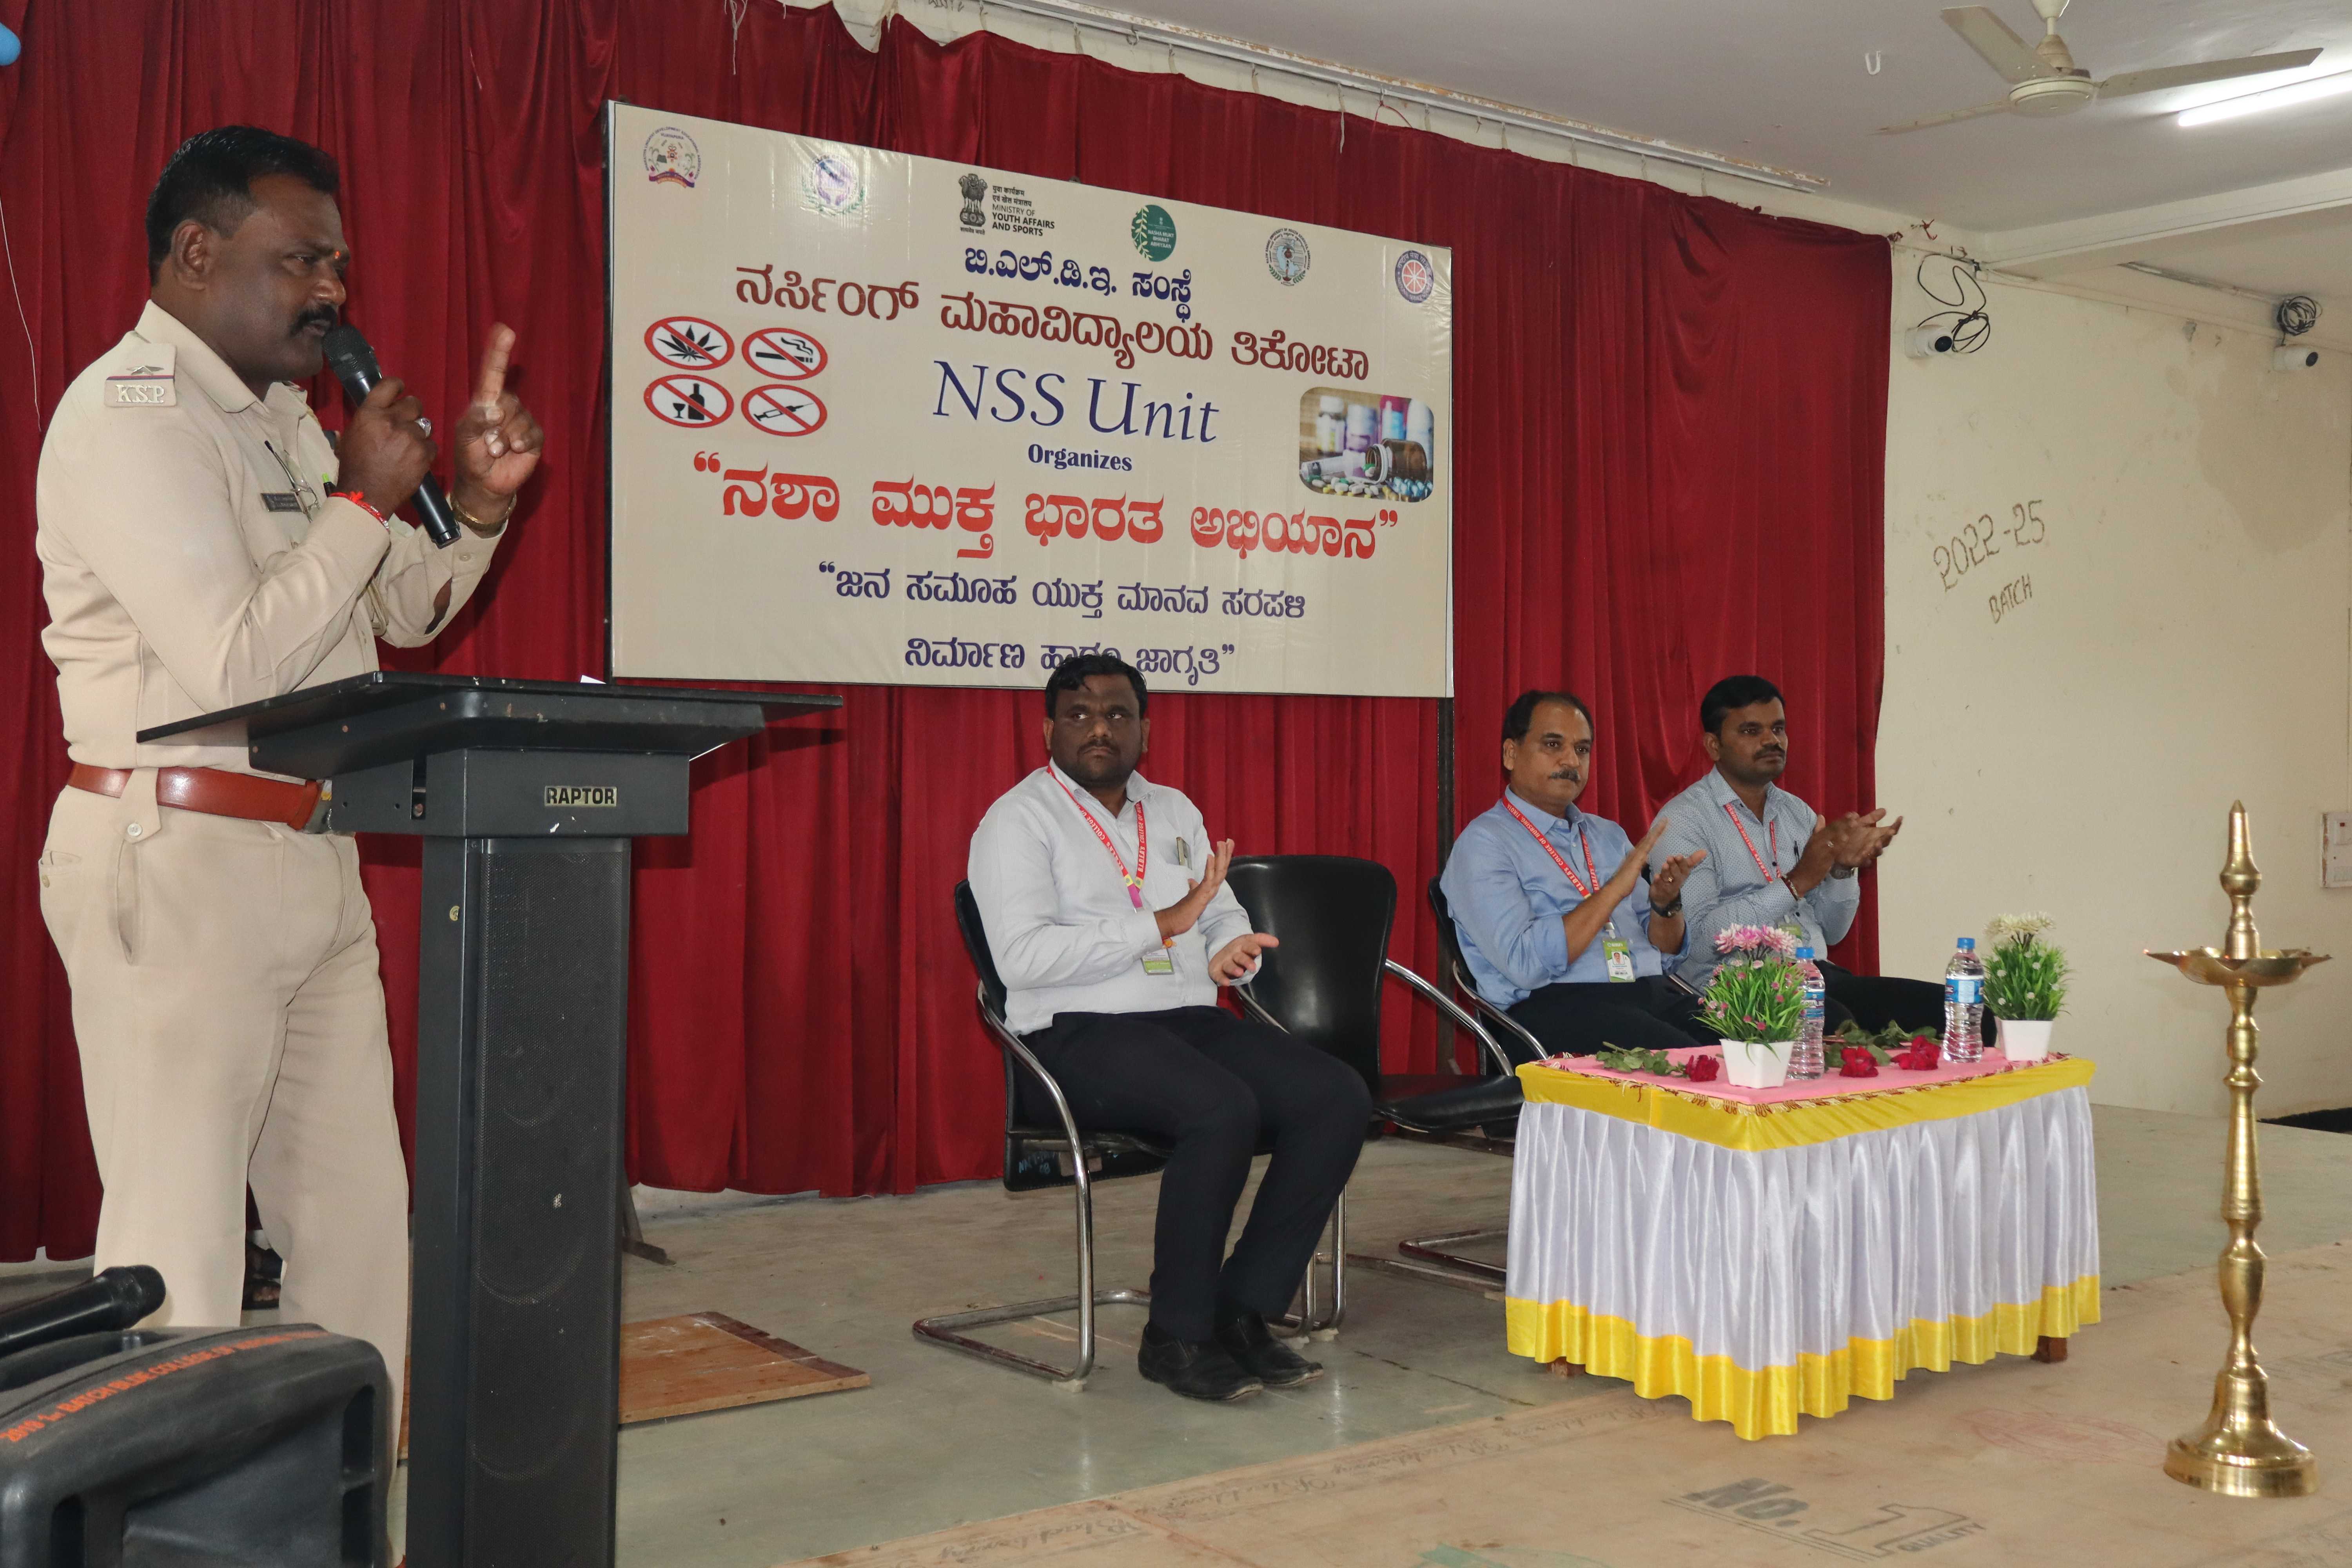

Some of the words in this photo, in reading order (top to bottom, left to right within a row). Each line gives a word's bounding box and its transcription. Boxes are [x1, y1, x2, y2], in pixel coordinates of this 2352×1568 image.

[992, 212, 1020, 223] YOUTH
[1023, 218, 1055, 229] AFFAIRS
[993, 203, 1024, 215] MINISTRY
[992, 222, 1010, 230] AND
[1013, 225, 1043, 236] SPORTS
[1132, 269, 1192, 322] ಸಂಸ್ಥೆ
[736, 264, 919, 321] ನರ್ಸಿಂಗ್
[941, 291, 1213, 370] ಮಹಾವಿದ್ಯಾಲಯ
[1231, 329, 1369, 381] ತಿಕೋಟಾ
[116, 384, 165, 404] KSP
[933, 360, 1065, 426] NSS
[1087, 378, 1220, 443] Unit
[1028, 444, 1132, 472] Organizes
[693, 451, 840, 523] “ನಶಾ
[872, 472, 996, 559] ಮುಕ್ತ
[1025, 492, 1164, 546] ಭಾರತ
[1191, 506, 1398, 559] ಅಭಿಯಾನ”
[818, 561, 891, 599] “ಜನ
[906, 570, 1017, 605] ಸಮೂಹ
[1032, 577, 1103, 619] ಯುಕ್ತ
[1118, 582, 1209, 614] ಮಾನವ
[1222, 588, 1305, 619] ಸರಪಳಿ
[1989, 574, 2033, 624] BATCH
[905, 637, 1025, 669] ನಿರ್ಮಾಣ
[547, 788, 615, 804] RAPTOR
[1544, 844, 1564, 866] COLLEGE
[1897, 1521, 1987, 1553] QUALITY
